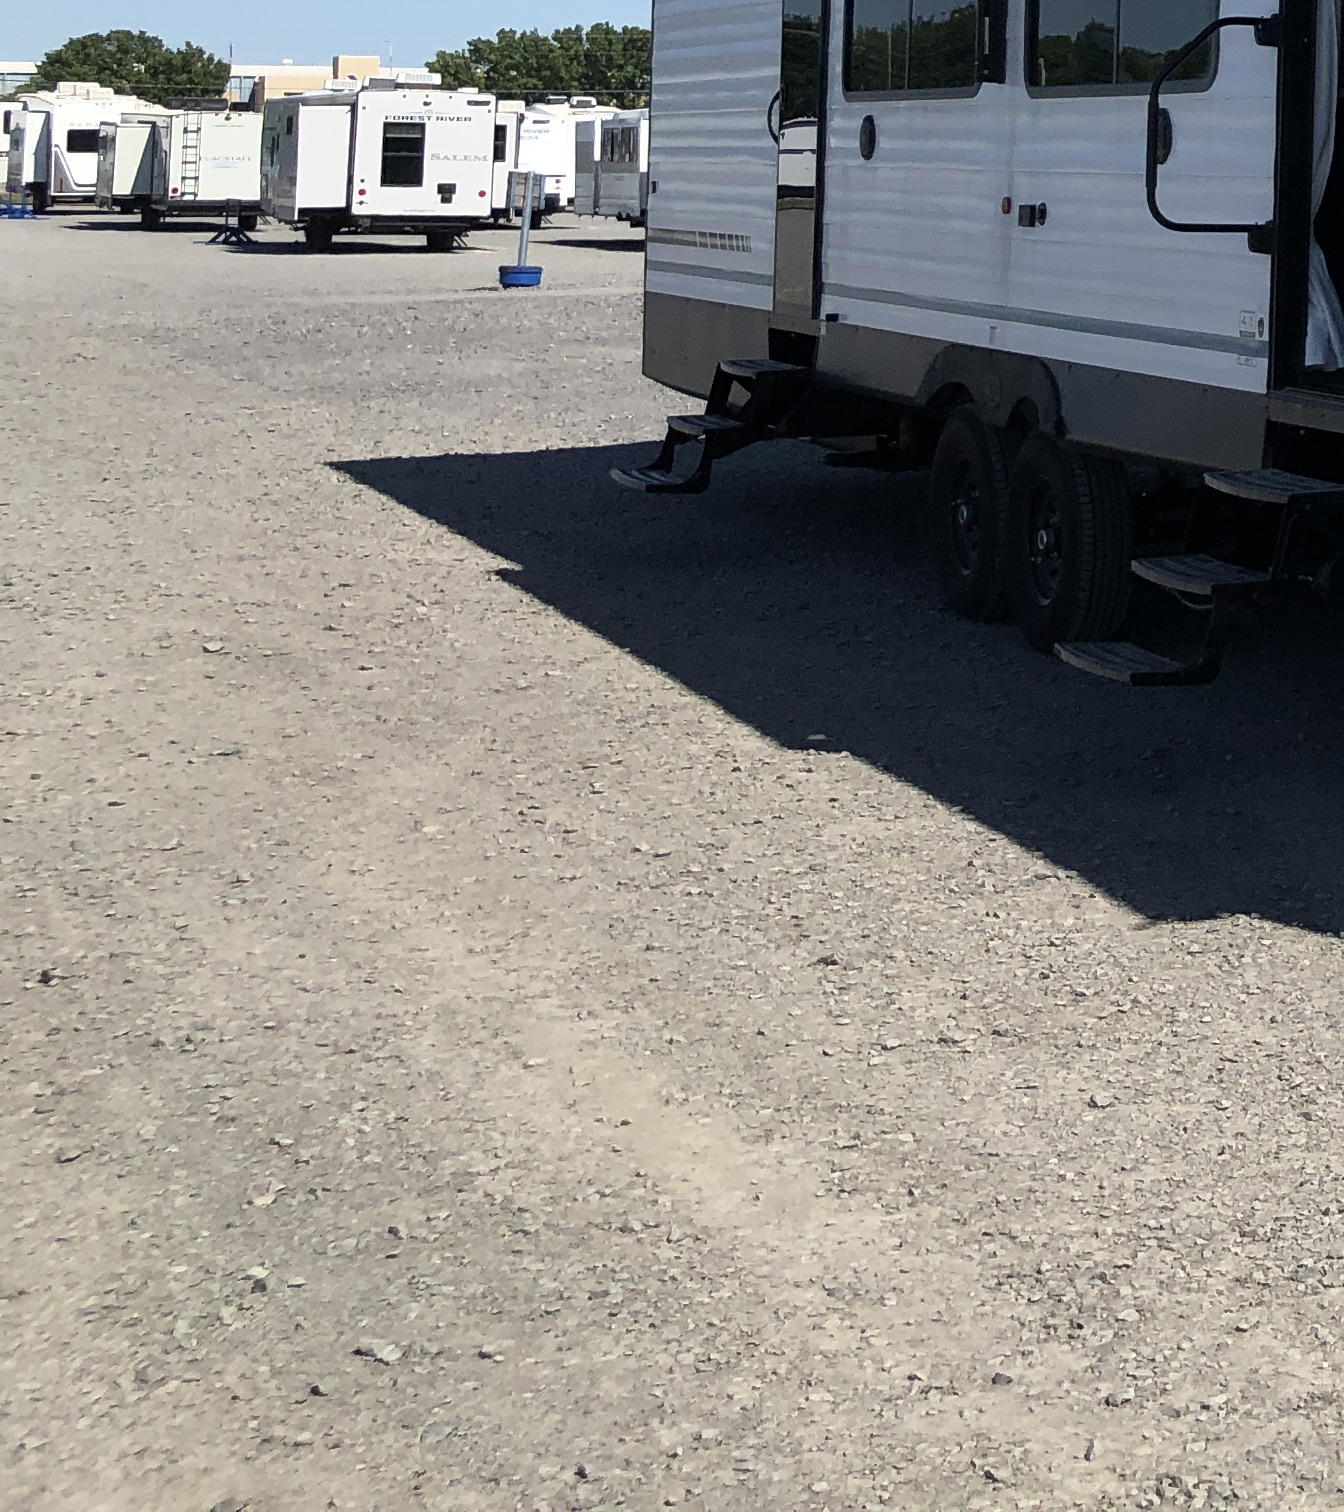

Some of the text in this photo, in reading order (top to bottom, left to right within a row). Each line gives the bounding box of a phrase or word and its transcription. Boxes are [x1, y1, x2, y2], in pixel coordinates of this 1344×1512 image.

[384, 114, 472, 123] FOREST RIVER
[430, 152, 489, 162] SALEM
